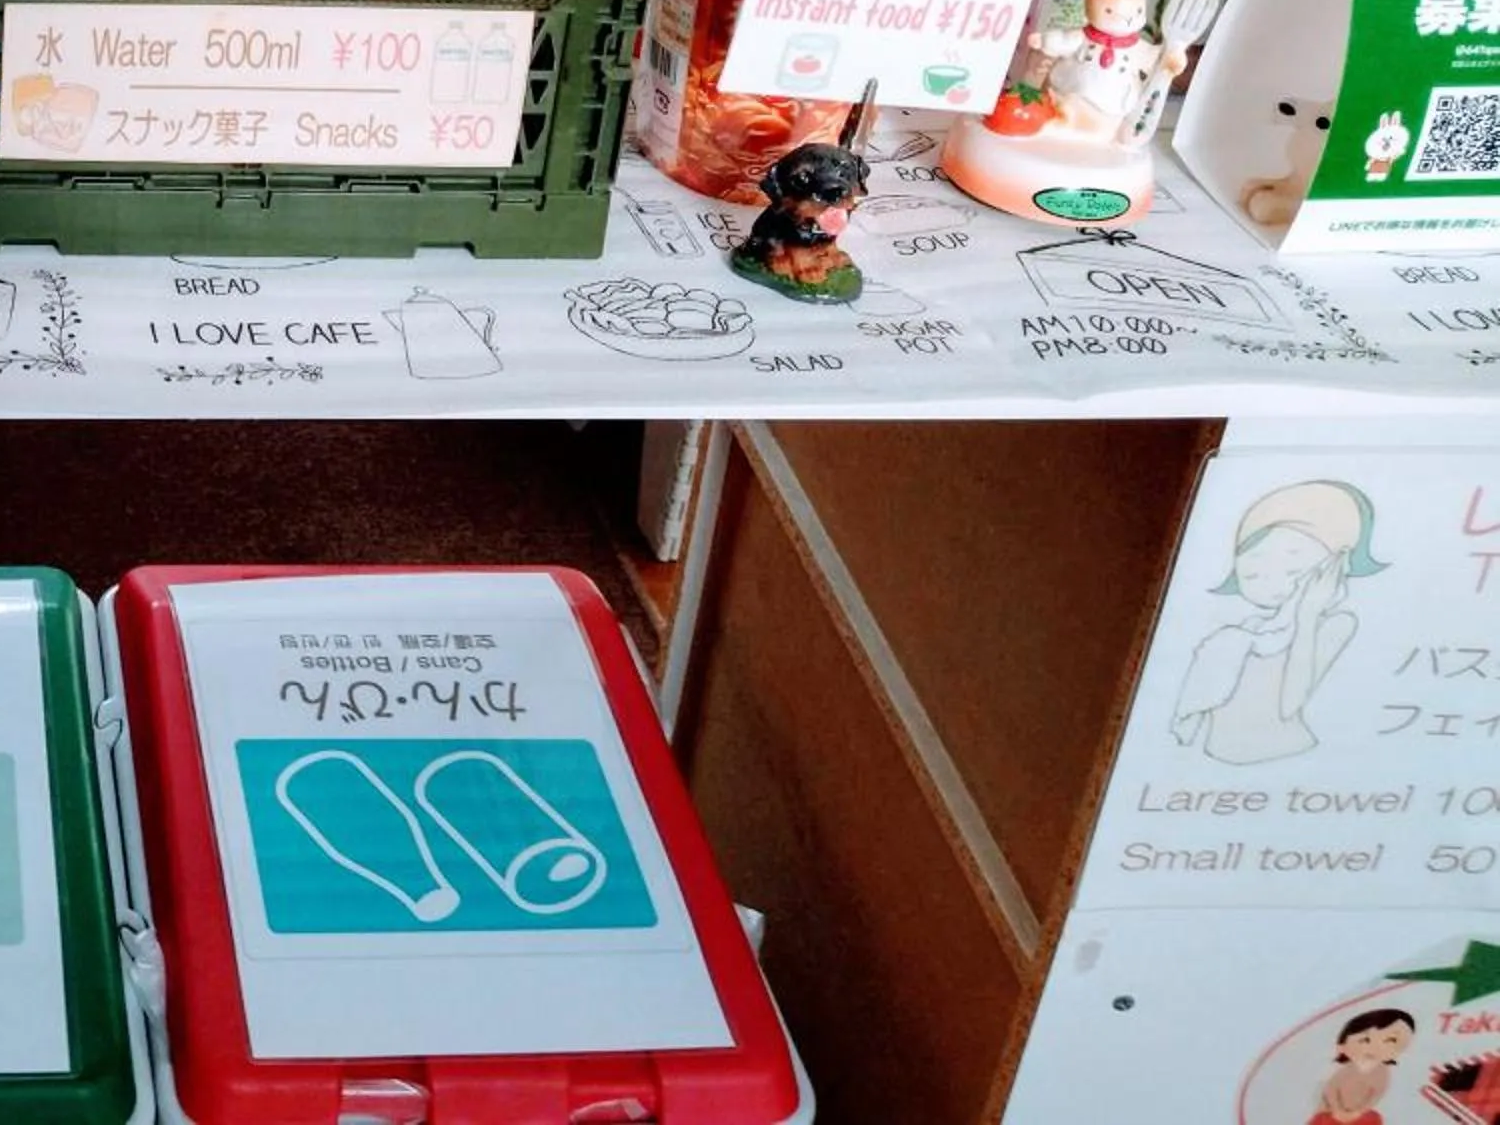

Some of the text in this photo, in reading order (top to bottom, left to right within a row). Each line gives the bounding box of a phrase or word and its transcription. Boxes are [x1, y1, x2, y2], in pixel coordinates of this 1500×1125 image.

[939, 0, 1015, 42] ¥150
[36, 28, 421, 72] 水 Water 500ml ¥100
[106, 109, 496, 150] スナック菓子 Snacks ¥50
[696, 213, 742, 232] ICE
[893, 231, 970, 256] SOUP
[174, 277, 261, 296] BREAD
[1392, 266, 1480, 284] BREAD
[1086, 269, 1227, 308] OPEN
[856, 319, 964, 337] SUGAR
[1407, 311, 1432, 331] I
[149, 322, 379, 345] I LOVE CAFE
[894, 336, 954, 355] POT
[1031, 336, 1168, 361] PM8:00
[749, 354, 844, 373] SALAD
[300, 654, 393, 673] Bottles
[416, 655, 483, 673] Cans
[1395, 646, 1500, 681] バス
[279, 680, 527, 724] かん・びん
[1138, 783, 1500, 817] Large towel 10
[1120, 842, 1497, 876] Small towel 50
